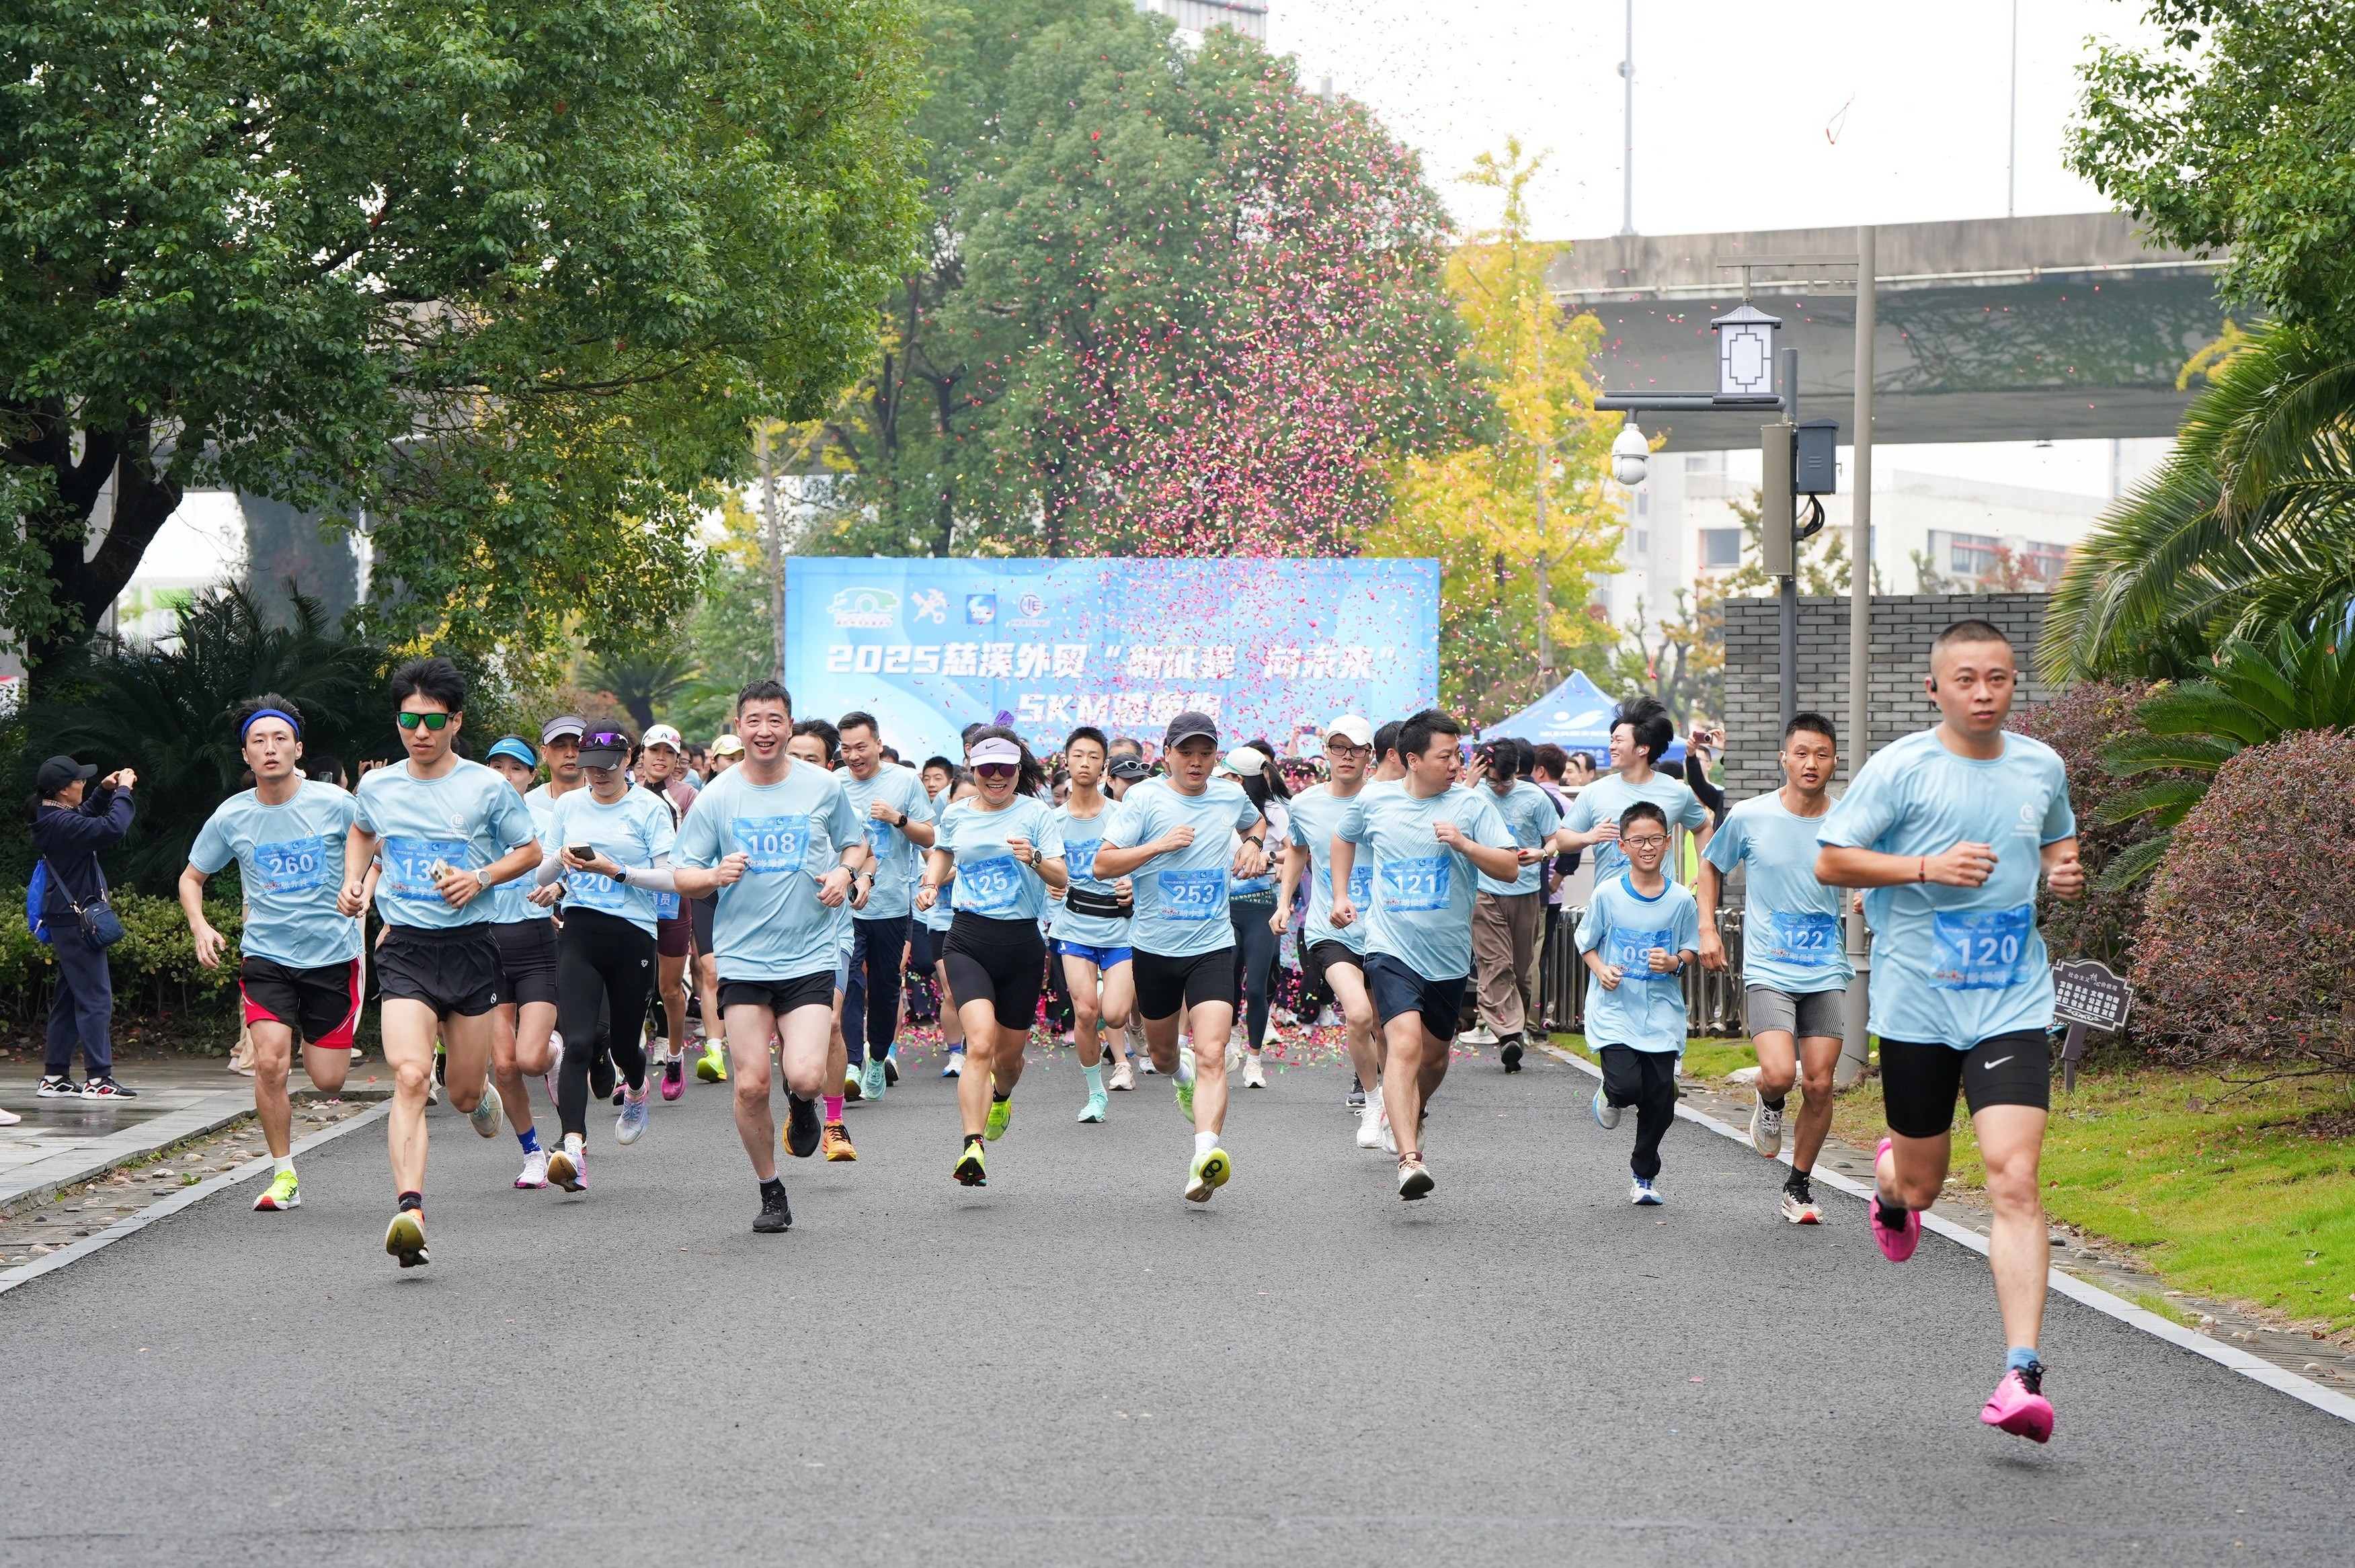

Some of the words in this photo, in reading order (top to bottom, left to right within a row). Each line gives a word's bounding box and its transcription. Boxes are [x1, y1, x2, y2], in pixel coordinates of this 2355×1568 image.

[748, 833, 795, 855] 108
[269, 854, 313, 877] 260
[1067, 851, 1097, 867] 117
[403, 858, 432, 882] 13
[571, 873, 612, 893] 220
[968, 872, 1008, 897] 125
[1350, 878, 1372, 897] 51
[1394, 874, 1435, 895] 121
[1172, 884, 1215, 904] 253
[1785, 930, 1823, 950] 122
[1956, 934, 2018, 966] 120
[1623, 945, 1649, 966] 09
